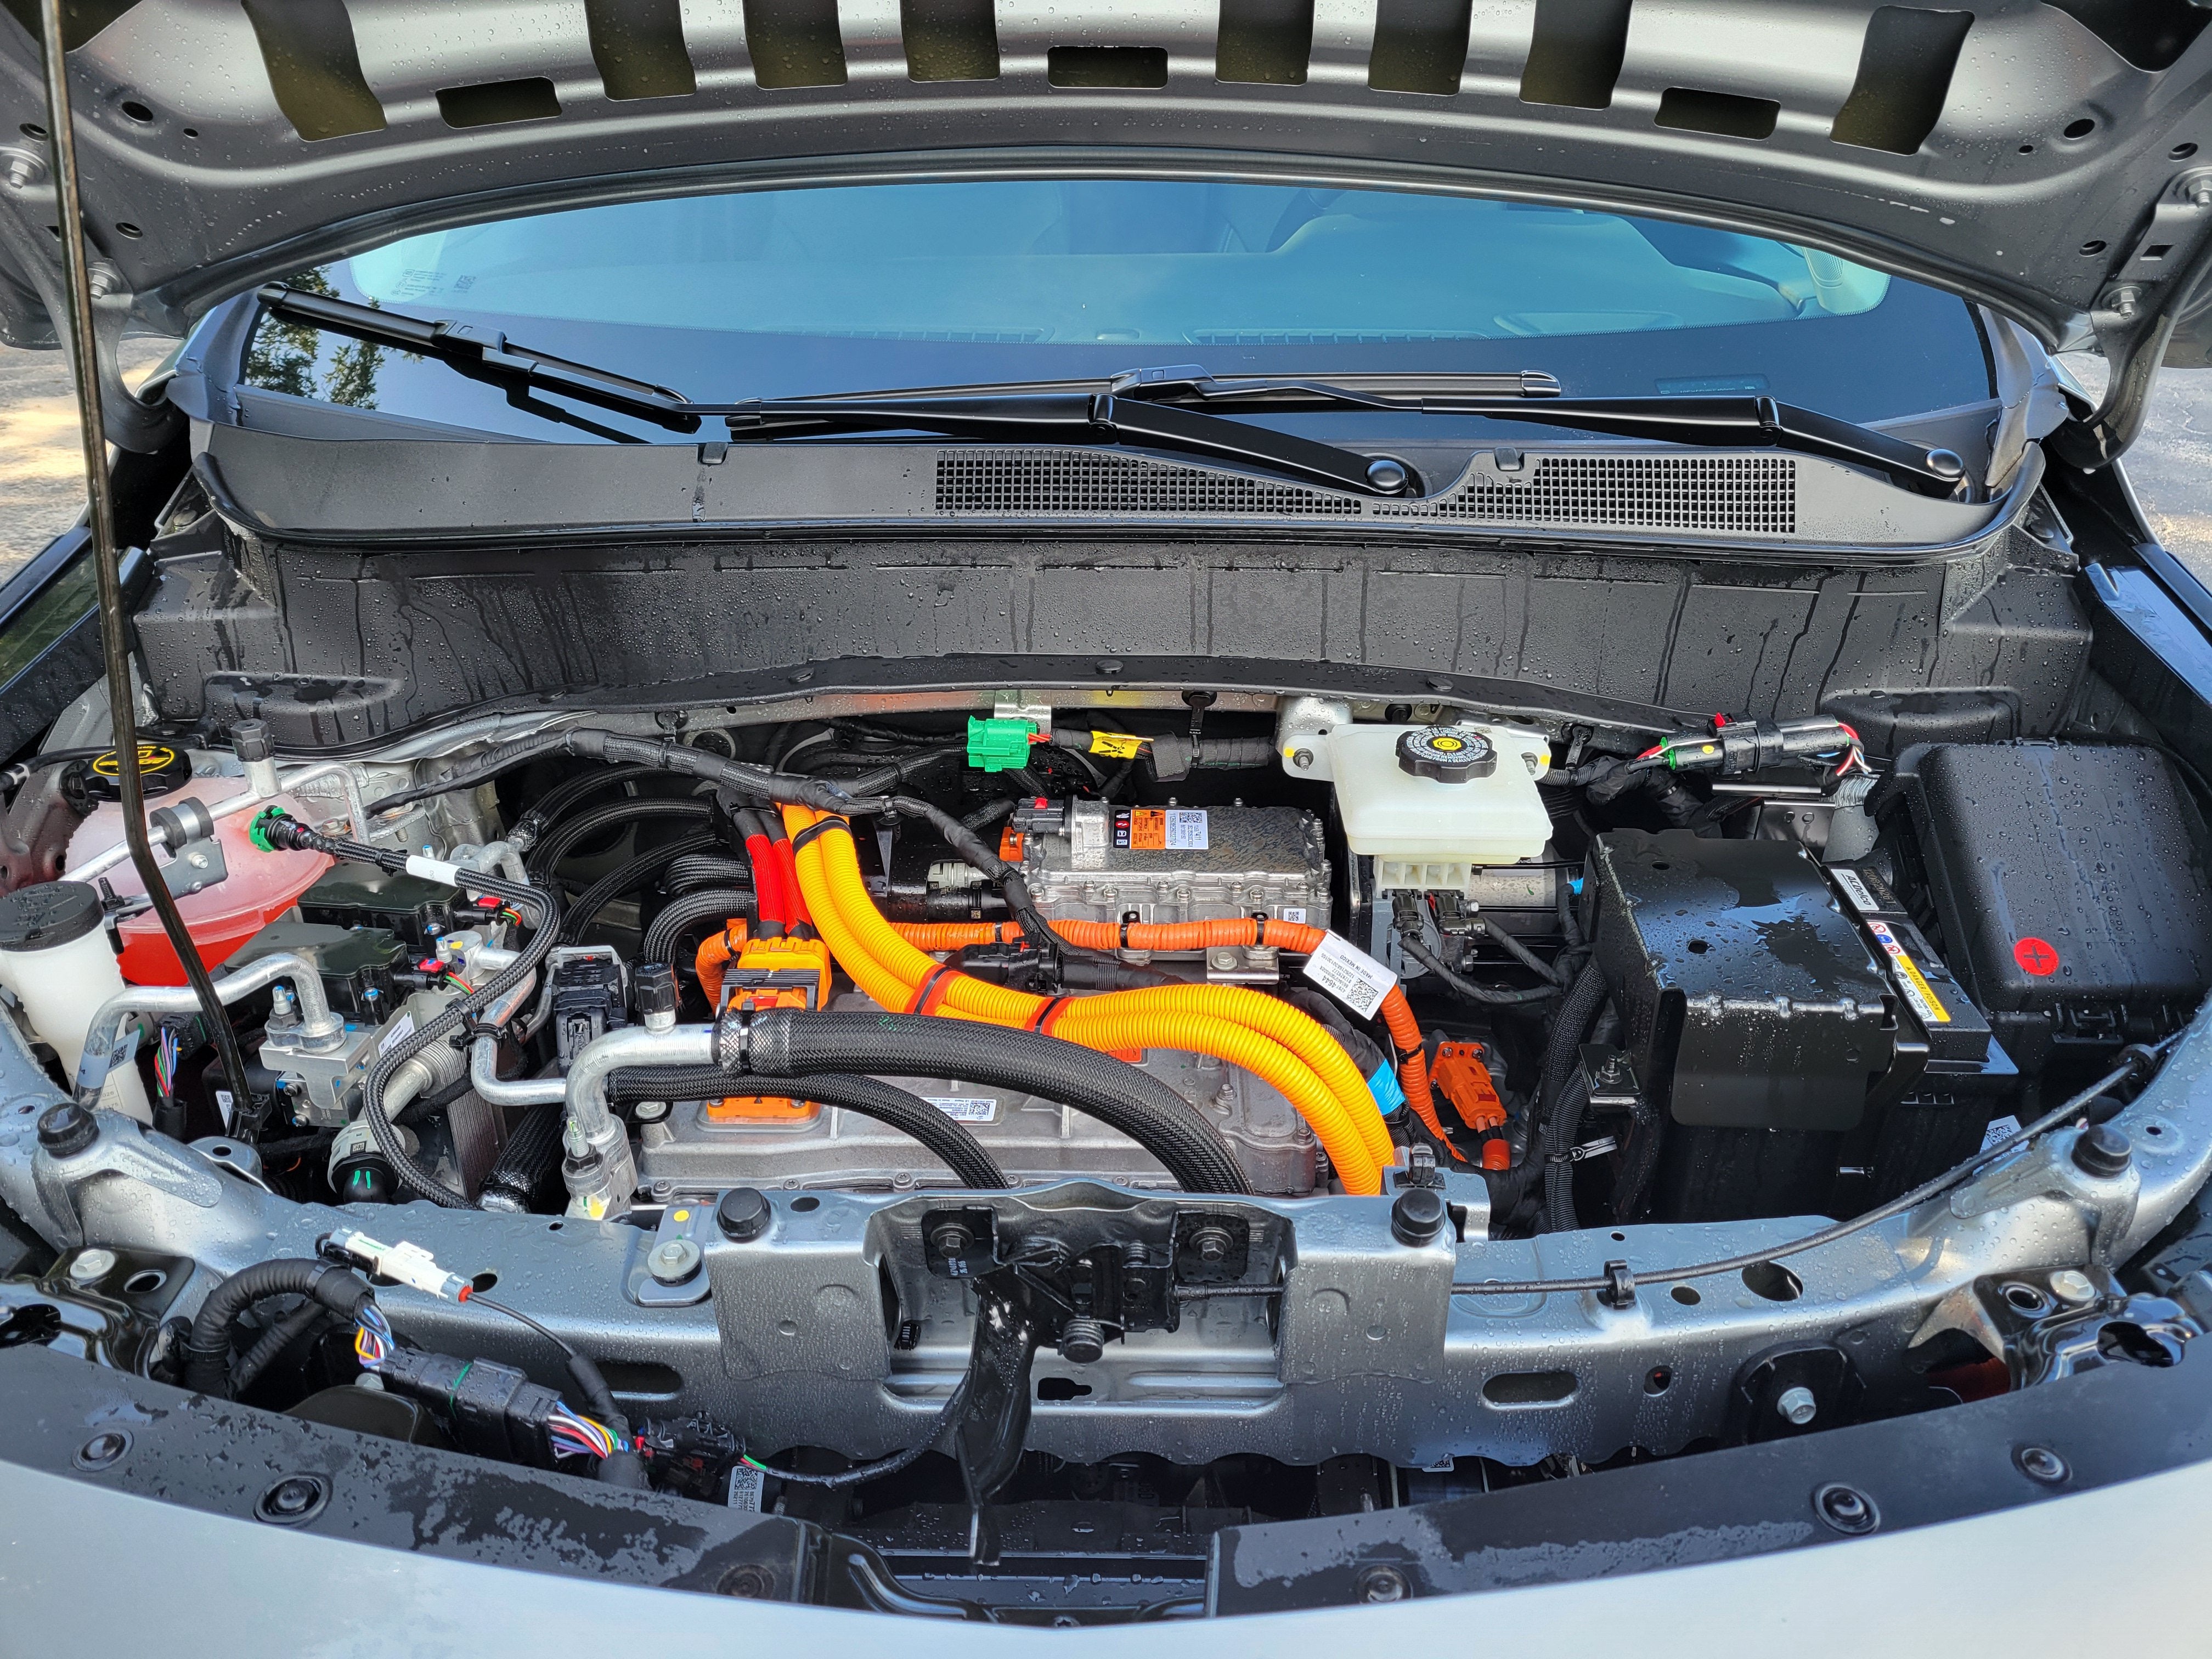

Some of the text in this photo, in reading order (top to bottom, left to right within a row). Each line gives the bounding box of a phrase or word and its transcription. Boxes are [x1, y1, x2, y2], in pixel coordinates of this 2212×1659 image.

[1846, 874, 1871, 905] ACDelco
[1339, 954, 1356, 967] MEXICO
[1361, 969, 1373, 979] MADE
[1322, 975, 1337, 988] 4644
[1909, 971, 1927, 989] DANGER
[1923, 992, 1940, 1010] POISON
